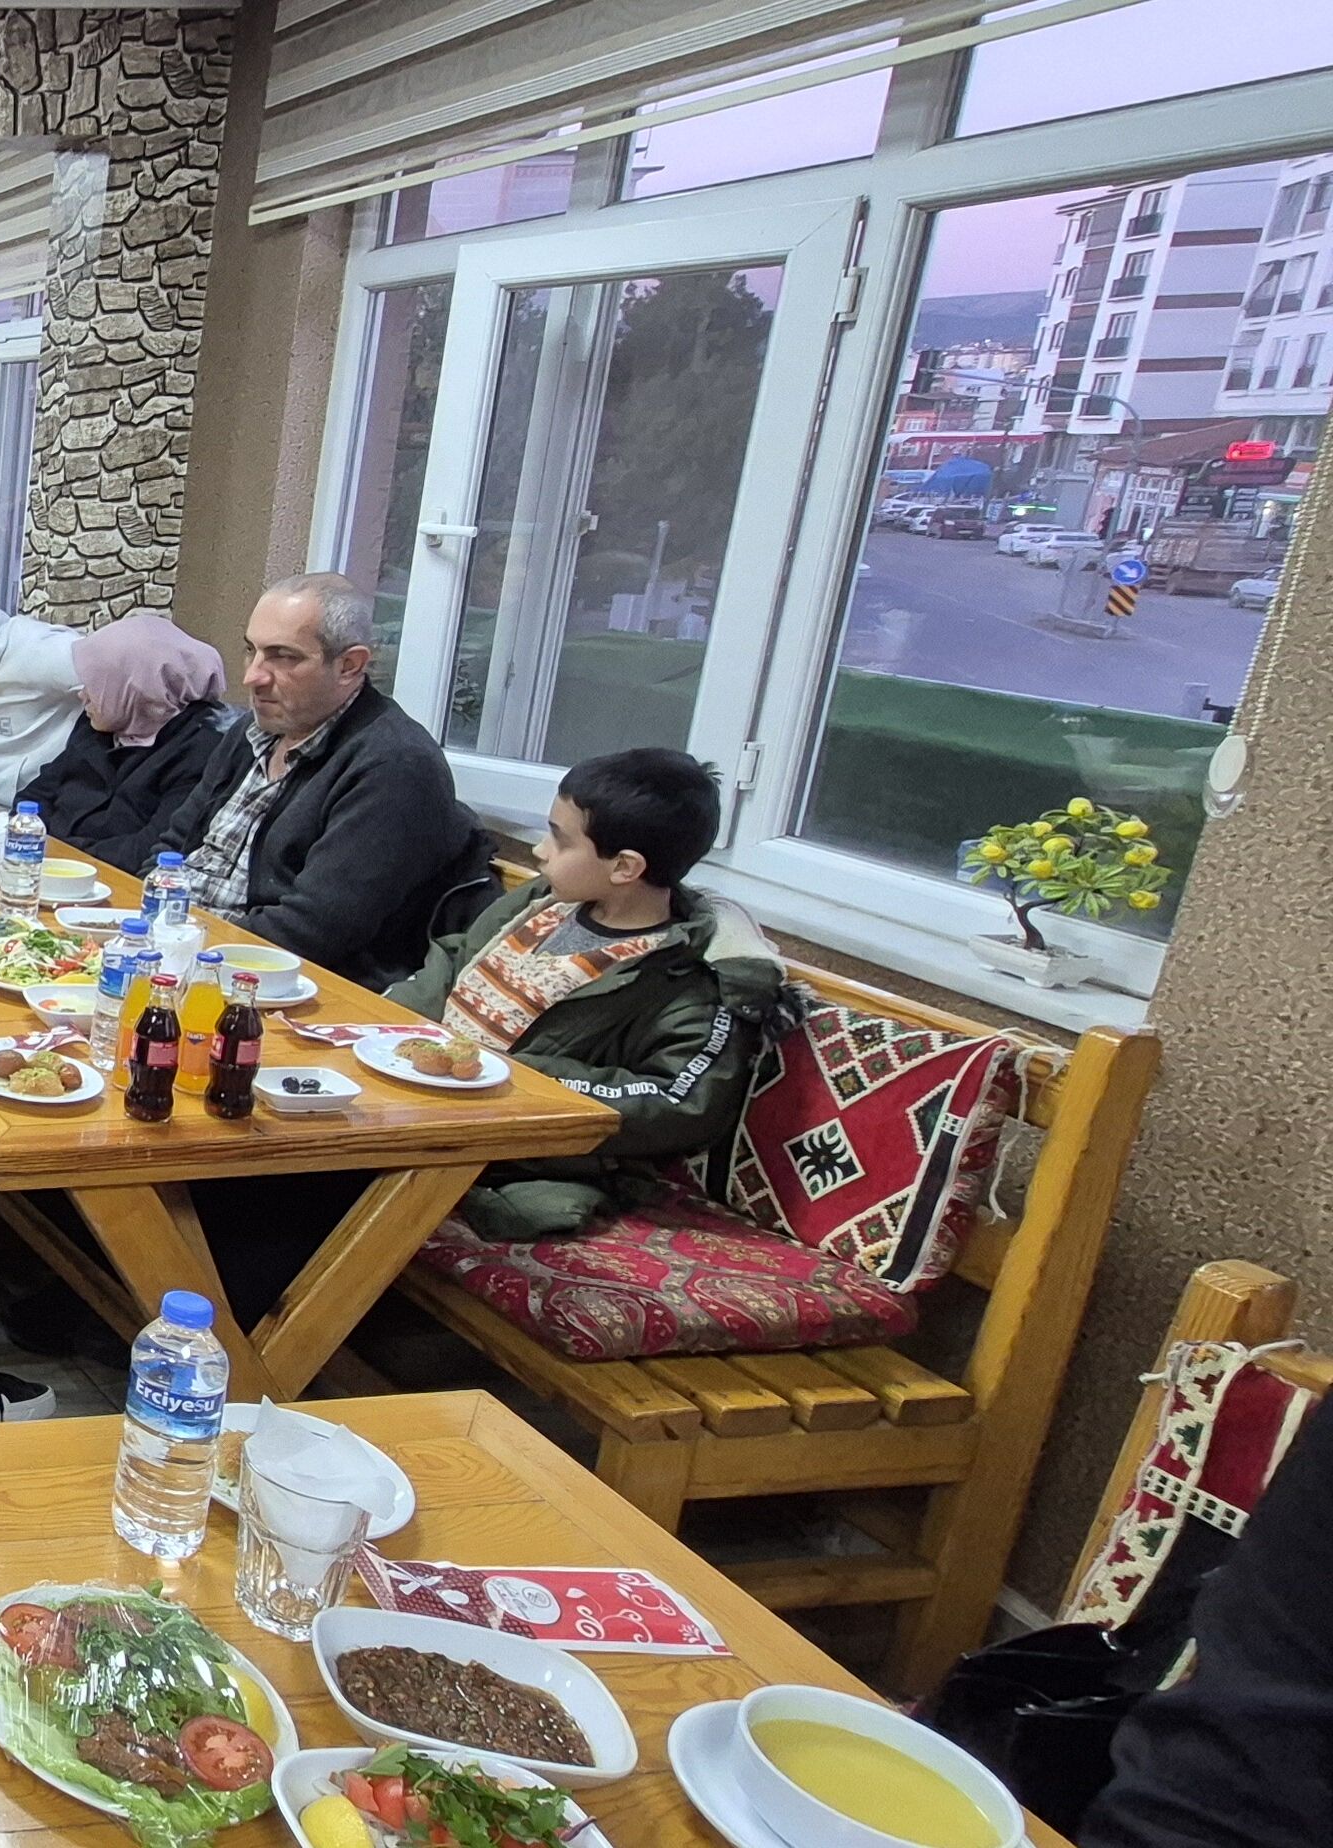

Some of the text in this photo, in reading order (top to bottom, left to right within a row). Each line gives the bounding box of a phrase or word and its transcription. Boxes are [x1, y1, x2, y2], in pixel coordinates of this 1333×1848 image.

[702, 1029, 729, 1055] COOL
[686, 1053, 713, 1075] KEEP
[592, 1084, 622, 1099] KEEP
[624, 1081, 659, 1096] COOL
[668, 1071, 696, 1096] COOL
